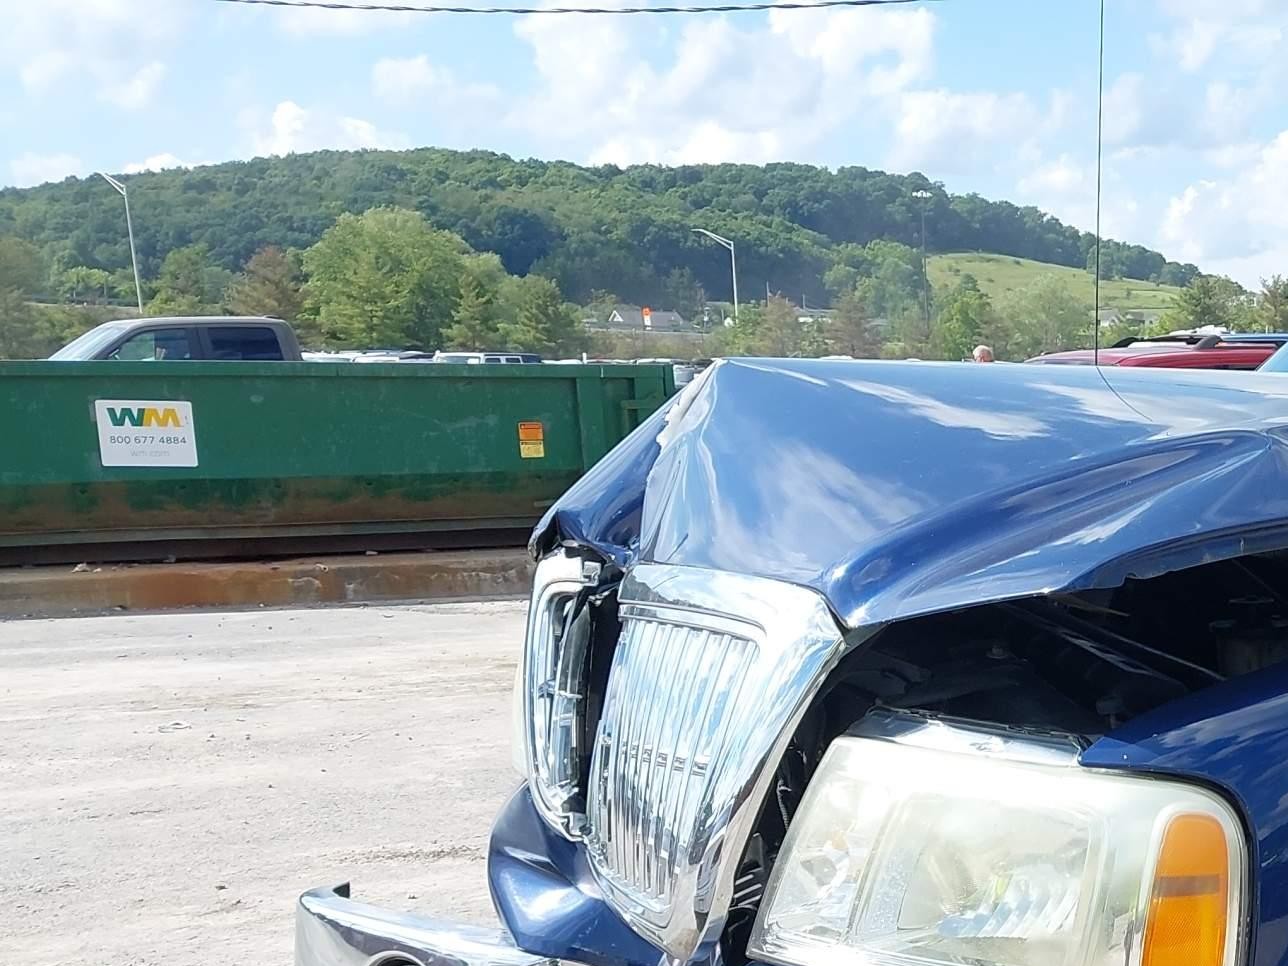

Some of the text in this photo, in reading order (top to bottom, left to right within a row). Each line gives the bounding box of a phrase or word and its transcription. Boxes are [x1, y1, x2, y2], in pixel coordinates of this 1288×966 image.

[106, 407, 182, 427] WM
[109, 435, 188, 446] 800 677 4884
